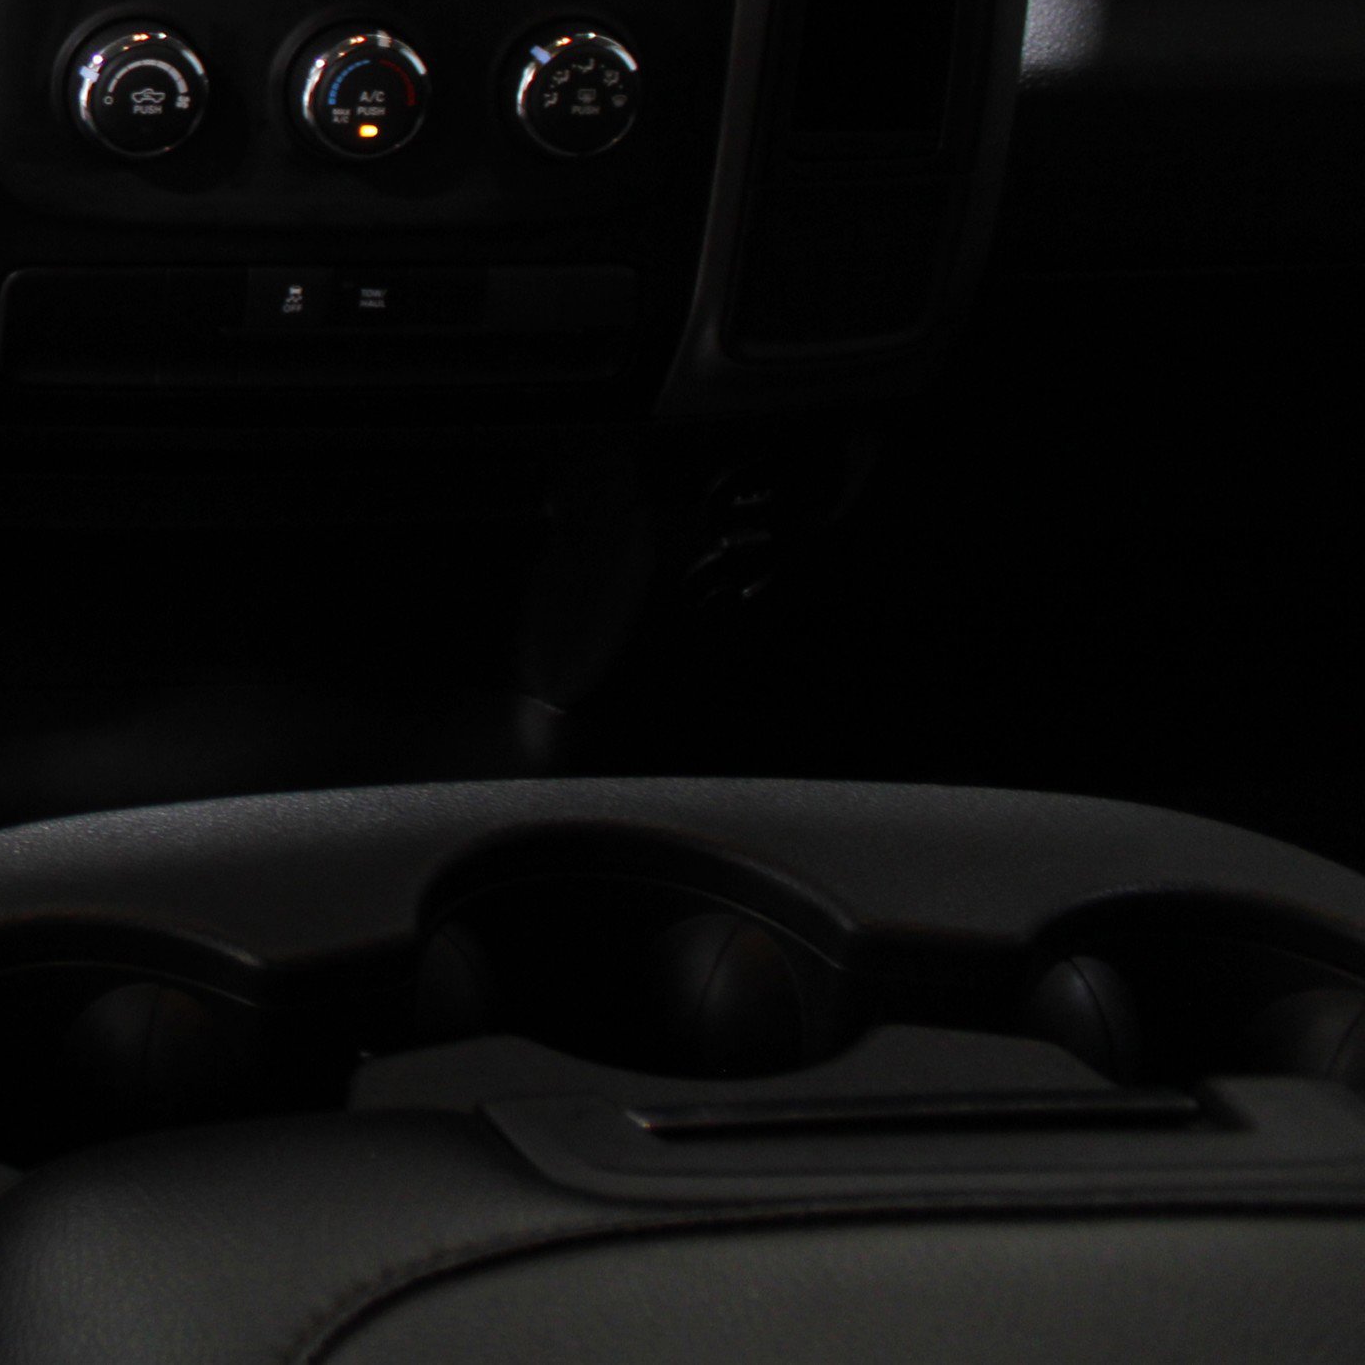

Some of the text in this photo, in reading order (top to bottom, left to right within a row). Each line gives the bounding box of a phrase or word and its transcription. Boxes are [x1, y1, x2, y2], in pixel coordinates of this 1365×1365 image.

[359, 90, 386, 103] A/C
[132, 105, 163, 115] PUSH
[356, 106, 386, 117] PUSH
[571, 106, 600, 115] PUSH
[282, 302, 304, 314] OFF
